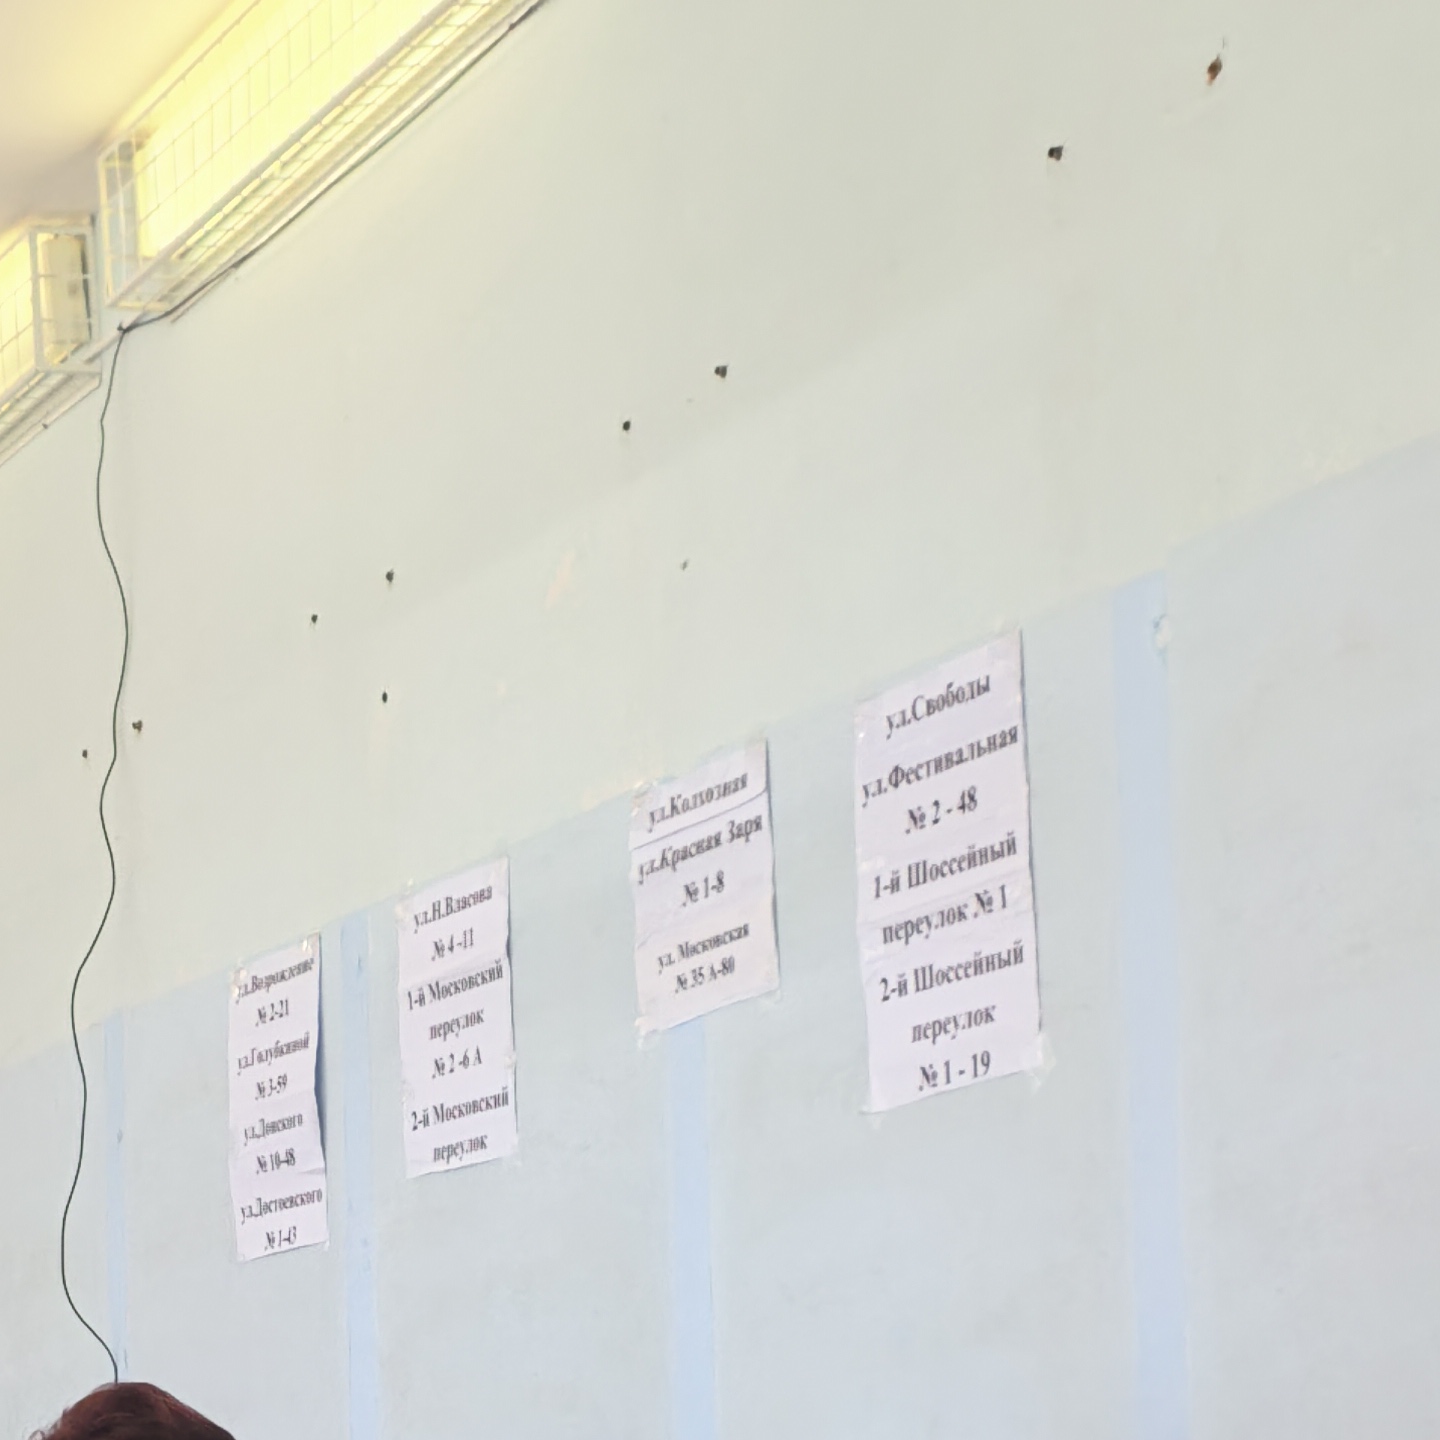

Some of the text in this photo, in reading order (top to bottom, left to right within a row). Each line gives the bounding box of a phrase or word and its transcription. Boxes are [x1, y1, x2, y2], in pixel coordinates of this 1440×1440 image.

[885, 674, 991, 740] ул.Свободы
[862, 725, 1019, 808] ул.Фестивальная
[648, 772, 748, 833] ул.Колхозная
[905, 806, 926, 834] №
[932, 799, 941, 825] 2
[957, 785, 978, 814] 48
[638, 814, 763, 885] ул.Красная Заря
[874, 830, 1018, 899] 1-й Шоссейный
[682, 870, 725, 907] № 1-8
[882, 884, 1007, 946] переулок № 1
[431, 938, 445, 961] №
[677, 923, 750, 963] Московская
[407, 958, 504, 1011] 1-й Московский
[674, 973, 688, 994] №
[879, 939, 1024, 1002] 2-й Шоссейный
[255, 1006, 267, 1027] №
[429, 1008, 484, 1042] переулок
[911, 1004, 997, 1045] переулок
[431, 1058, 445, 1079] №
[918, 1063, 938, 1091] №
[943, 1059, 951, 1085] 1
[971, 1050, 992, 1079] 19
[255, 1081, 266, 1100] №
[411, 1086, 509, 1131] 2-й Московский
[256, 1155, 267, 1174] №
[433, 1135, 488, 1164] переулок
[264, 1232, 275, 1251] №
